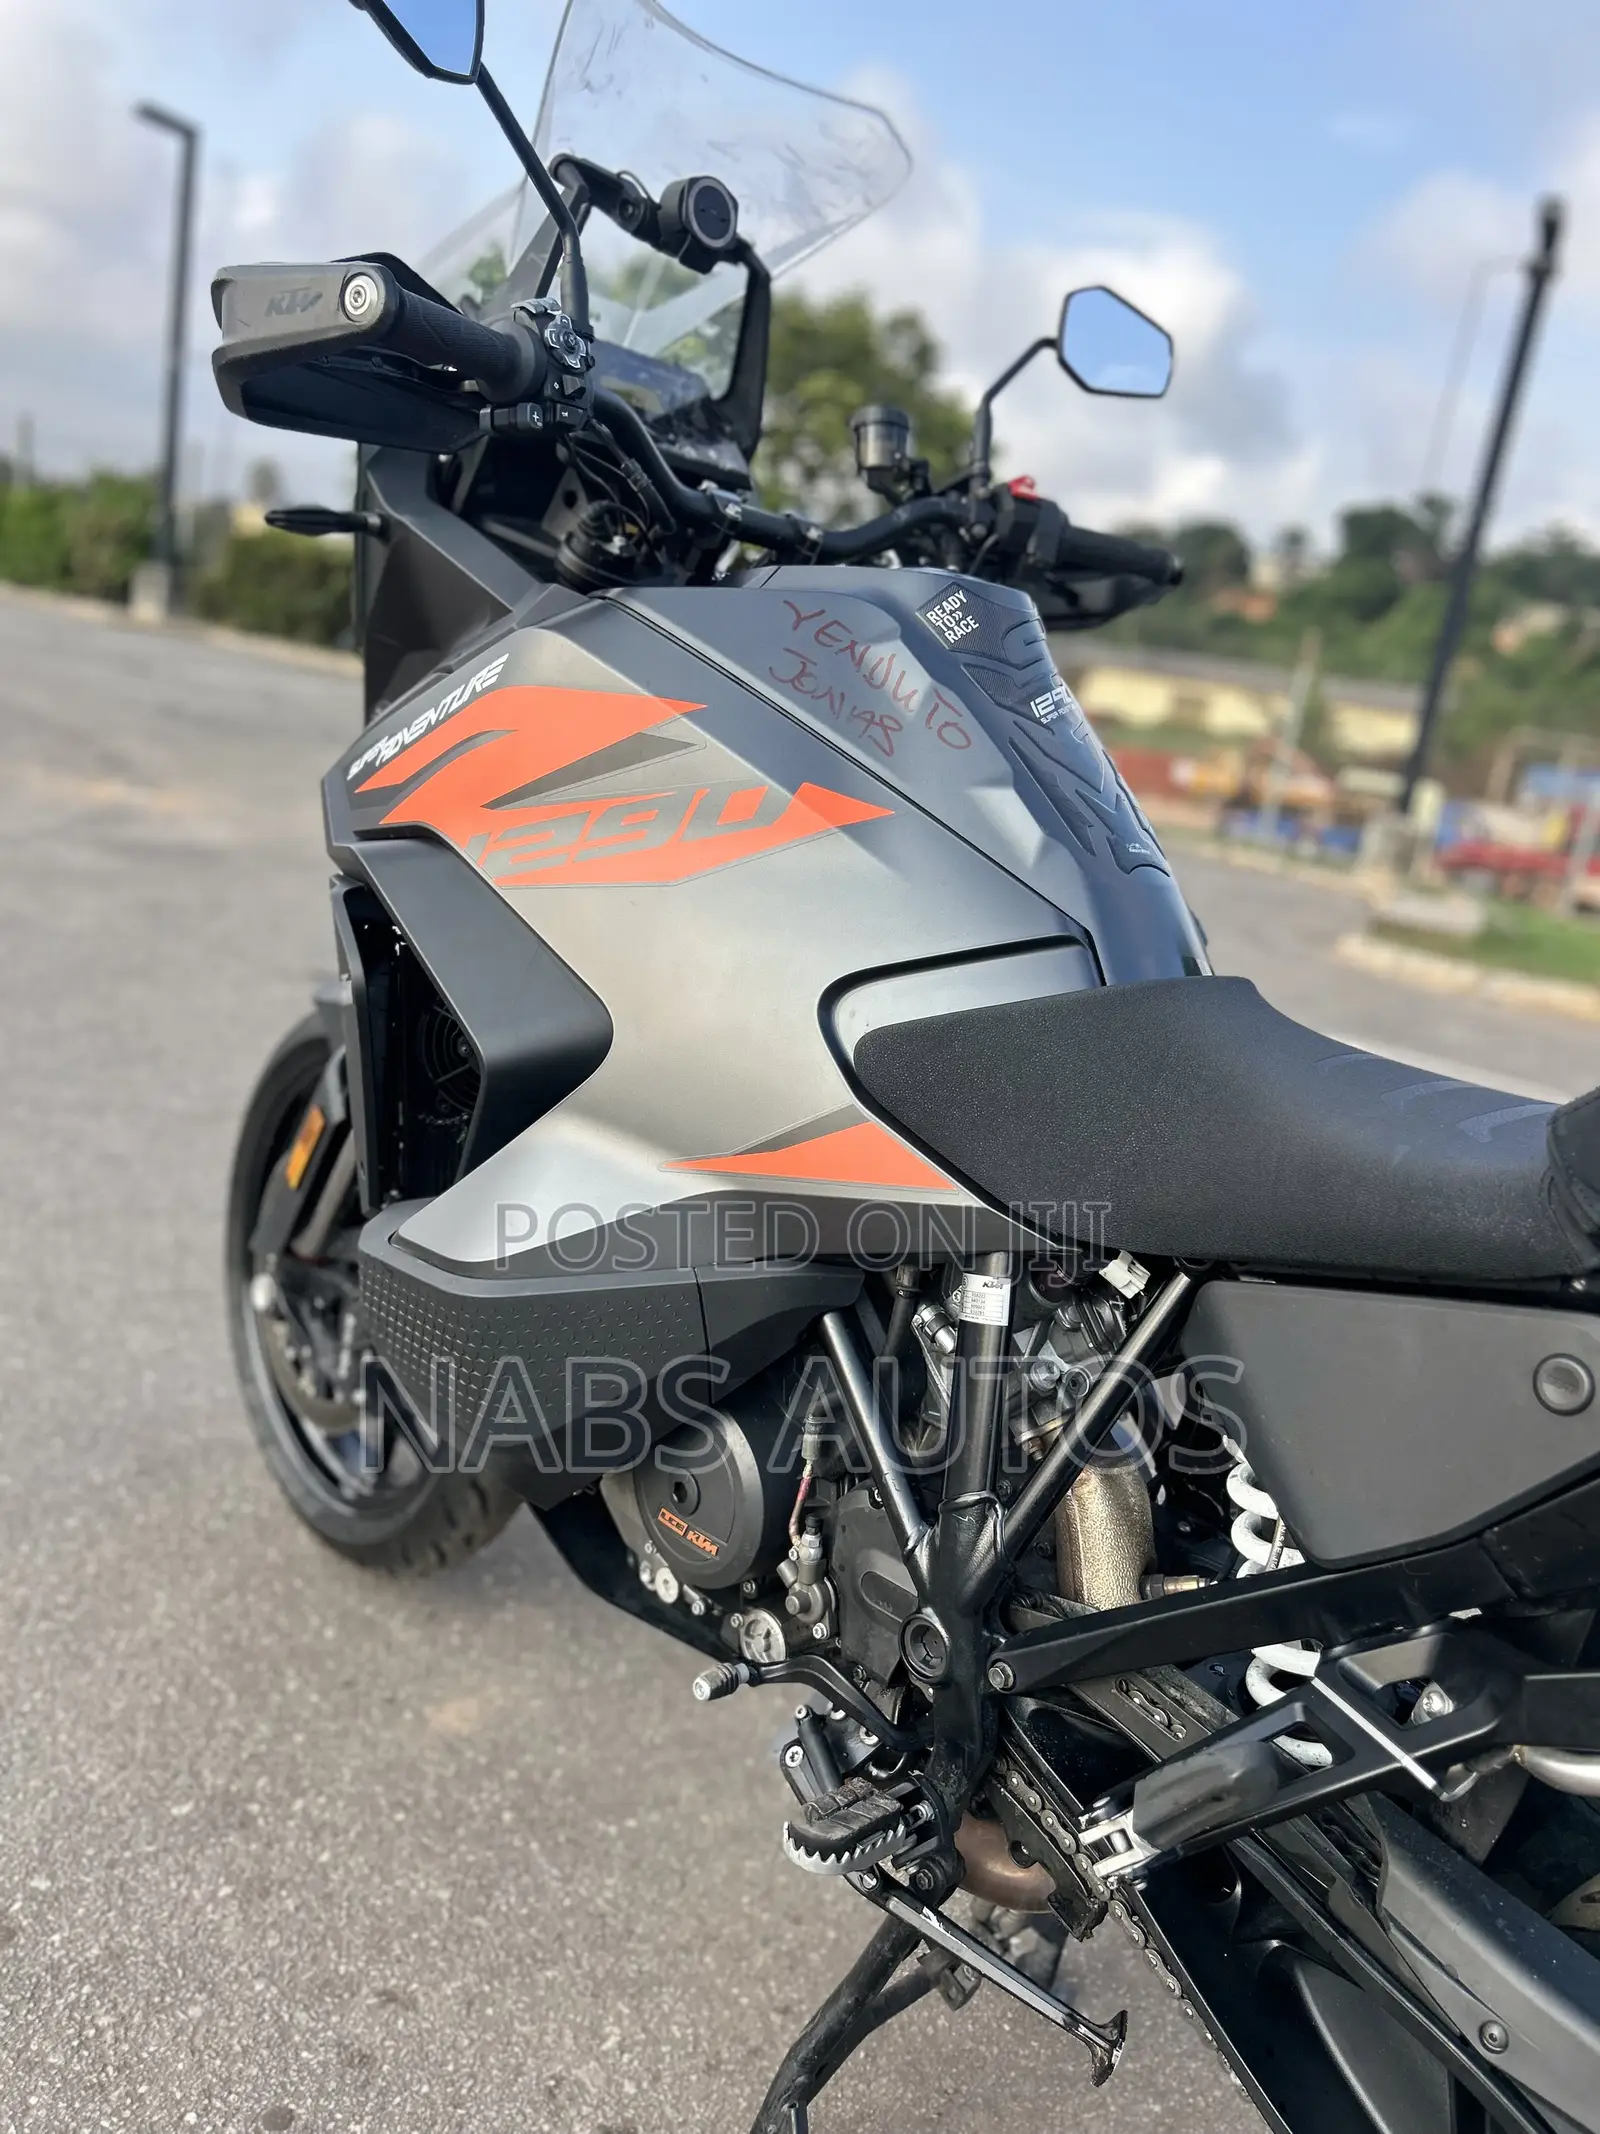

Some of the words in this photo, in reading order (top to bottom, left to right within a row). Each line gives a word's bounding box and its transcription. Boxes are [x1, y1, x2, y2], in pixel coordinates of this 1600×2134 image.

[926, 590, 967, 624] READY
[944, 615, 980, 644] RACE
[462, 779, 794, 880] 1290
[687, 1530, 719, 1557] KTM
